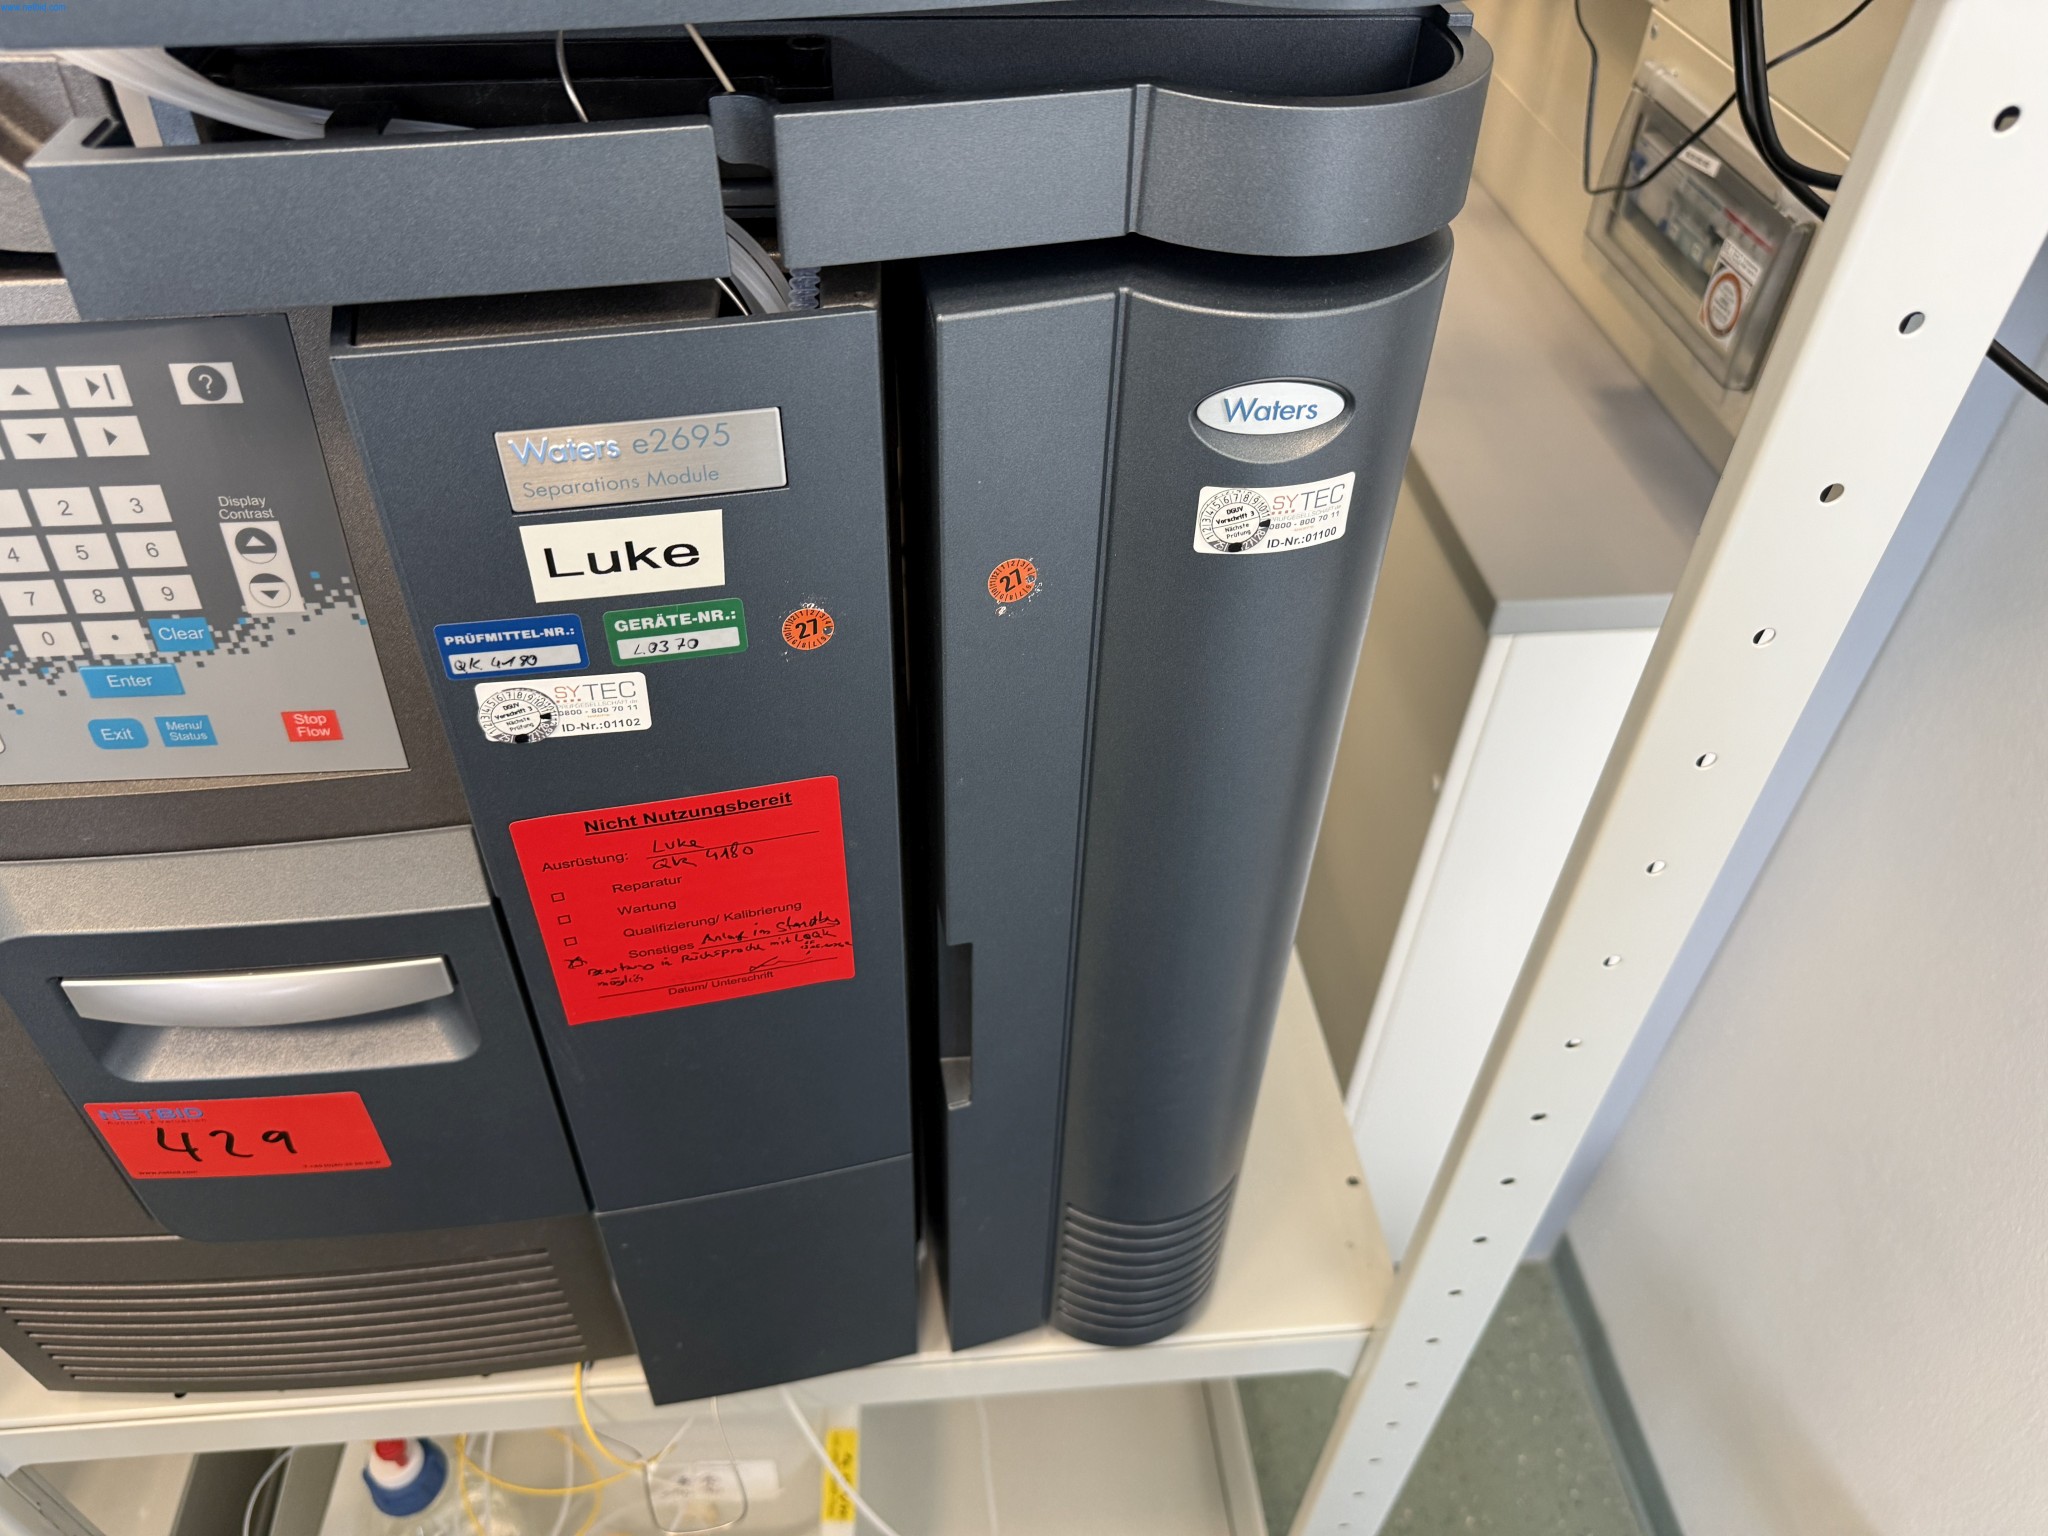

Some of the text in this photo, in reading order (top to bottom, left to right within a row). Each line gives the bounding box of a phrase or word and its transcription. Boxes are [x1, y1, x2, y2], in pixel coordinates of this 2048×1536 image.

[1223, 397, 1318, 423] Waters
[508, 422, 730, 466] Waters e2695
[522, 465, 719, 501] Separations Module
[218, 495, 266, 510] Display
[1273, 483, 1345, 511] SYTEC
[56, 500, 73, 517] 2
[129, 498, 145, 514] 3
[218, 507, 275, 521] Contrast
[1226, 506, 1244, 515] DGUV
[1216, 513, 1248, 525] Vorschrift
[1269, 522, 1292, 530] 0800
[1300, 518, 1316, 526] 800
[1319, 514, 1328, 522] 70
[1331, 510, 1340, 518] 11
[1225, 523, 1249, 533] Nächste
[1227, 529, 1252, 539] Prüfung
[1267, 526, 1337, 549] ID-Nr.:01100
[7, 547, 20, 562] 4
[75, 544, 89, 561] 5
[145, 542, 159, 558] 6
[543, 541, 700, 579] Luke
[1000, 568, 1022, 592] 27
[23, 591, 36, 607] 7
[92, 589, 106, 605] 8
[161, 586, 175, 602] 9
[614, 609, 737, 633] GERÄTE-NR.:
[795, 618, 818, 639] 27
[41, 631, 55, 647] 0
[158, 625, 205, 641] Clear
[443, 627, 575, 646] PRÜFMITTEL-NR.:
[491, 654, 537, 668] 4180
[106, 674, 153, 688] Enter
[554, 681, 636, 701] SYTEC
[293, 713, 327, 728] Stop
[559, 709, 582, 717] 0800
[165, 719, 203, 732] Menu/
[296, 725, 331, 738] Flow
[562, 718, 640, 732] ID-Nr.:01102
[100, 726, 134, 742] Exit
[169, 730, 208, 742] Status
[583, 791, 793, 834] Nicht Nutzungsbereit
[652, 837, 706, 854] Luke
[705, 842, 754, 861] 4180
[541, 852, 629, 873] Ausrüstung:
[612, 875, 683, 895] Reparatur
[616, 899, 678, 917] Wartung
[622, 902, 803, 938] Qualifizierung/ Kalibrierung
[628, 942, 695, 959] Sonstiges
[668, 970, 775, 996] Datum/ Unterschrift
[97, 1107, 203, 1121] NETBID
[157, 1127, 298, 1162] 429
